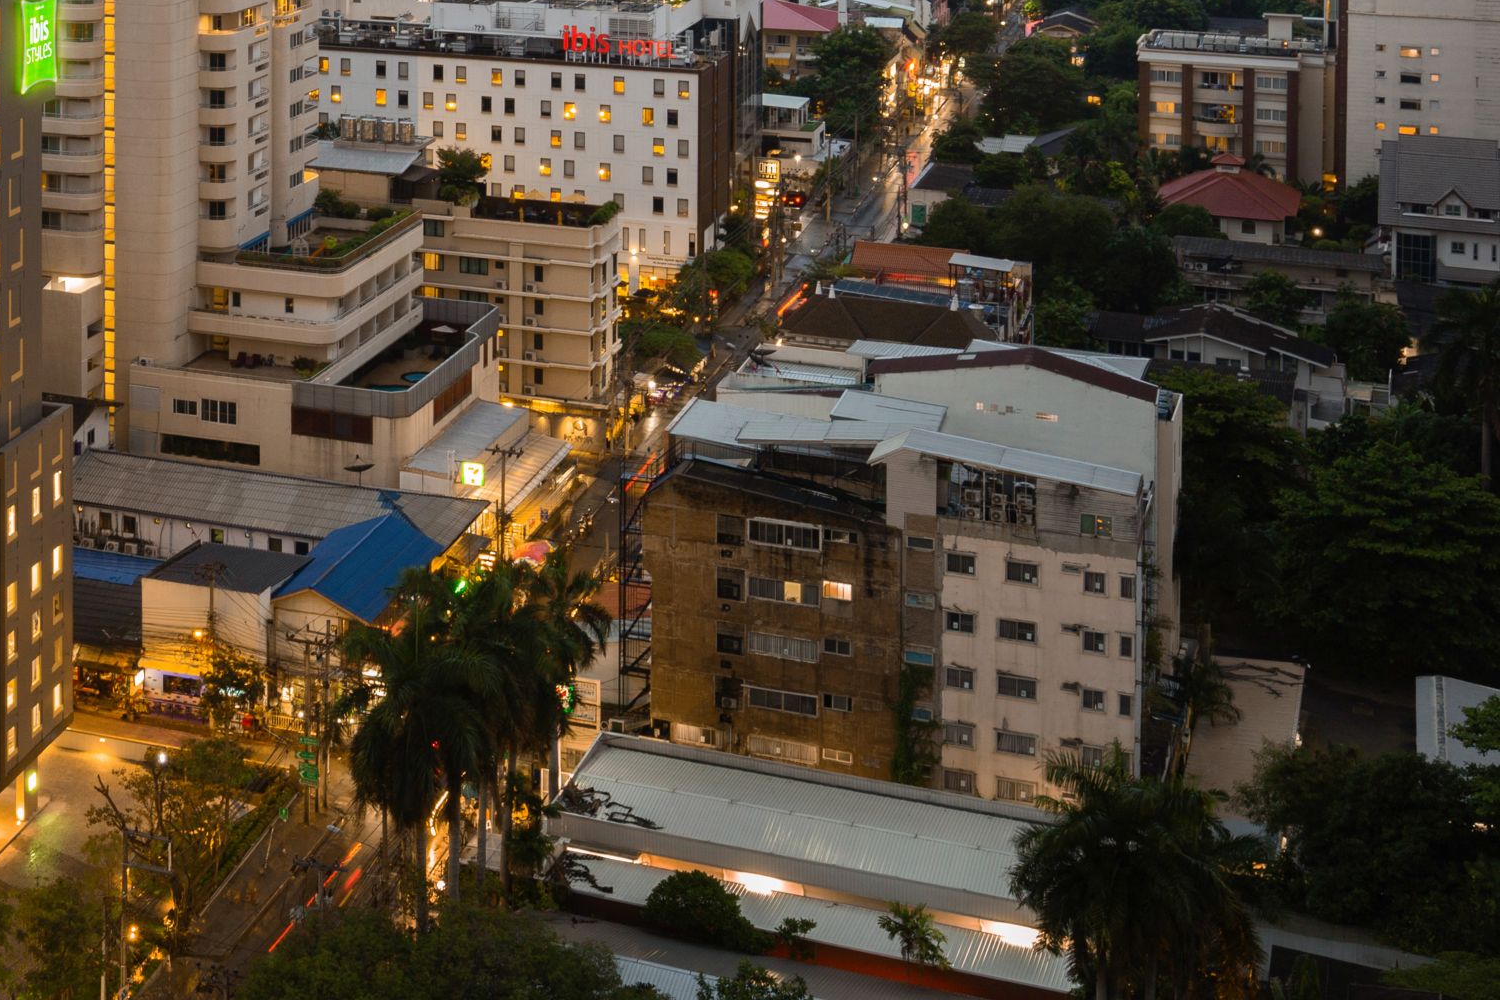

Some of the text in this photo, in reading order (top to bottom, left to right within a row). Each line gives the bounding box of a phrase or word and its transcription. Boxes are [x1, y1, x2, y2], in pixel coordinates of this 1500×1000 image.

[29, 15, 49, 45] ibis
[563, 25, 677, 59] ibis HOTEL
[26, 41, 52, 65] STYLES
